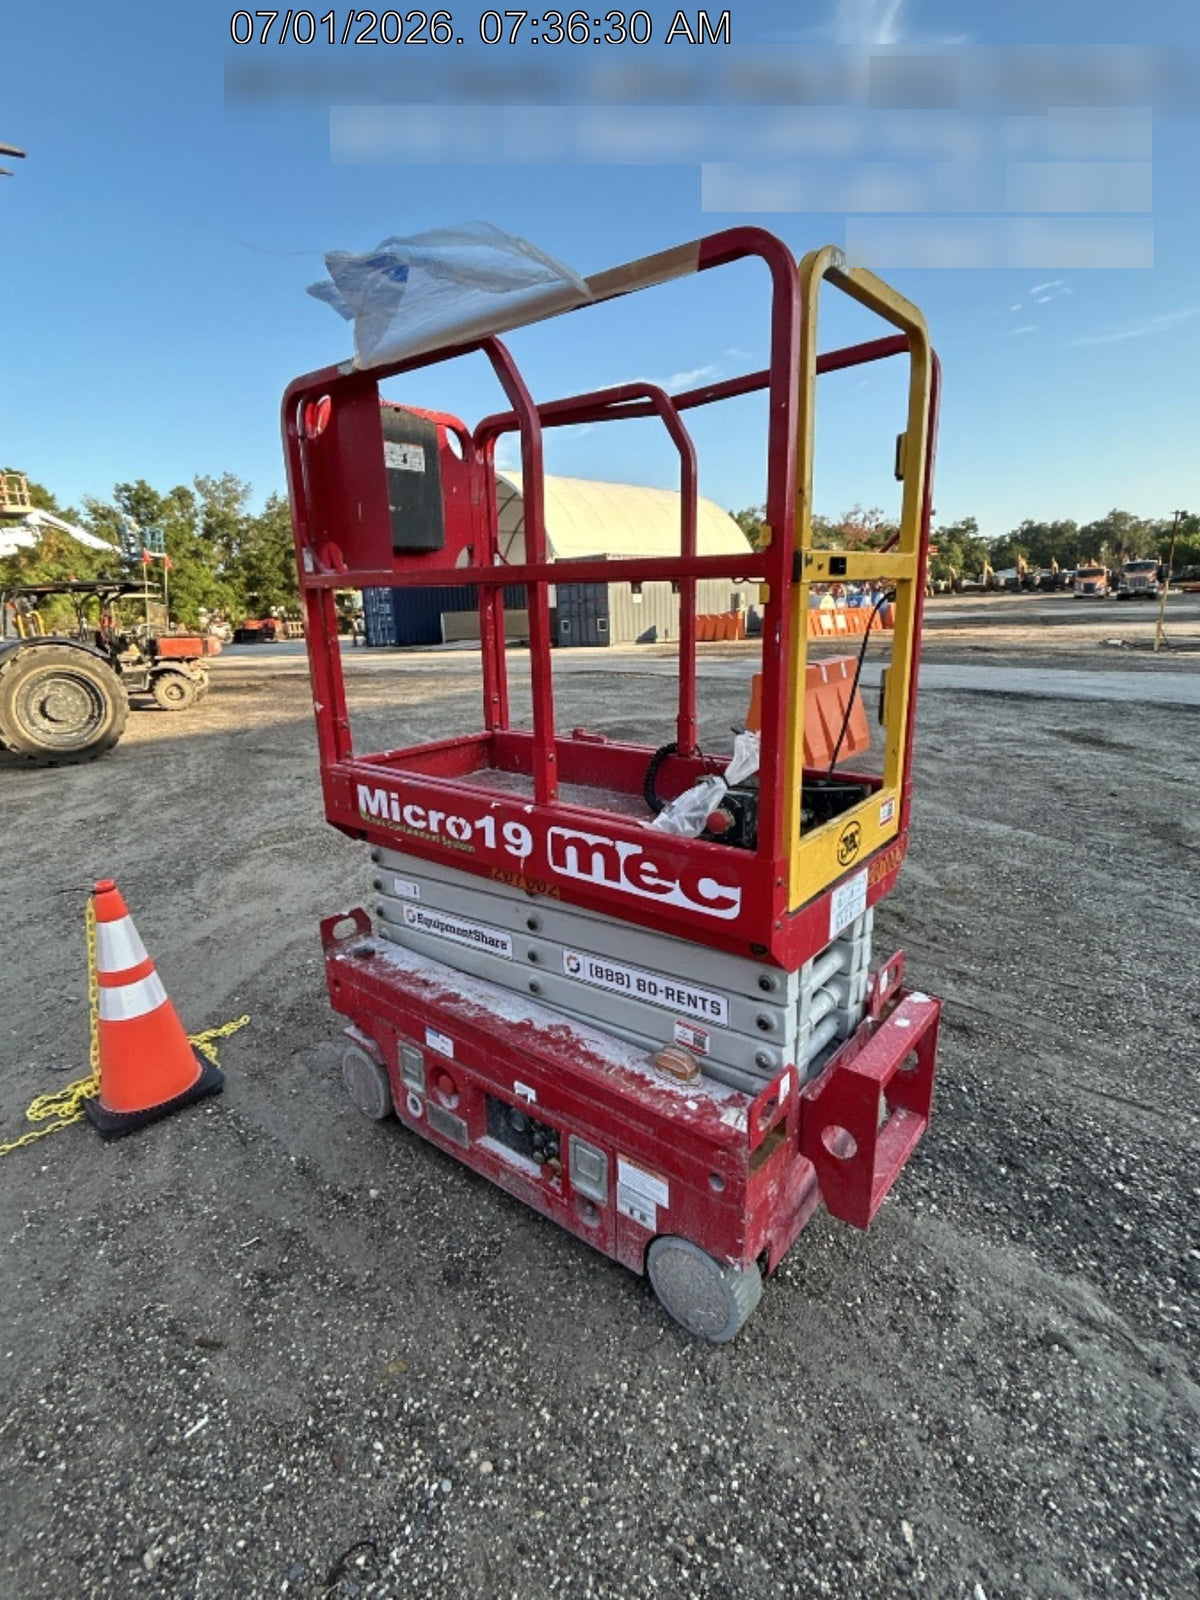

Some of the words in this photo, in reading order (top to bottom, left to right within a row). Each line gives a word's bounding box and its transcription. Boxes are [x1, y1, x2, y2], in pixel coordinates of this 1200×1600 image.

[356, 784, 534, 858] Micro19
[549, 828, 741, 917] mec
[417, 913, 508, 950] EquipmentShare
[589, 962, 630, 989] (888)
[636, 977, 722, 1016] 80-RENTS
